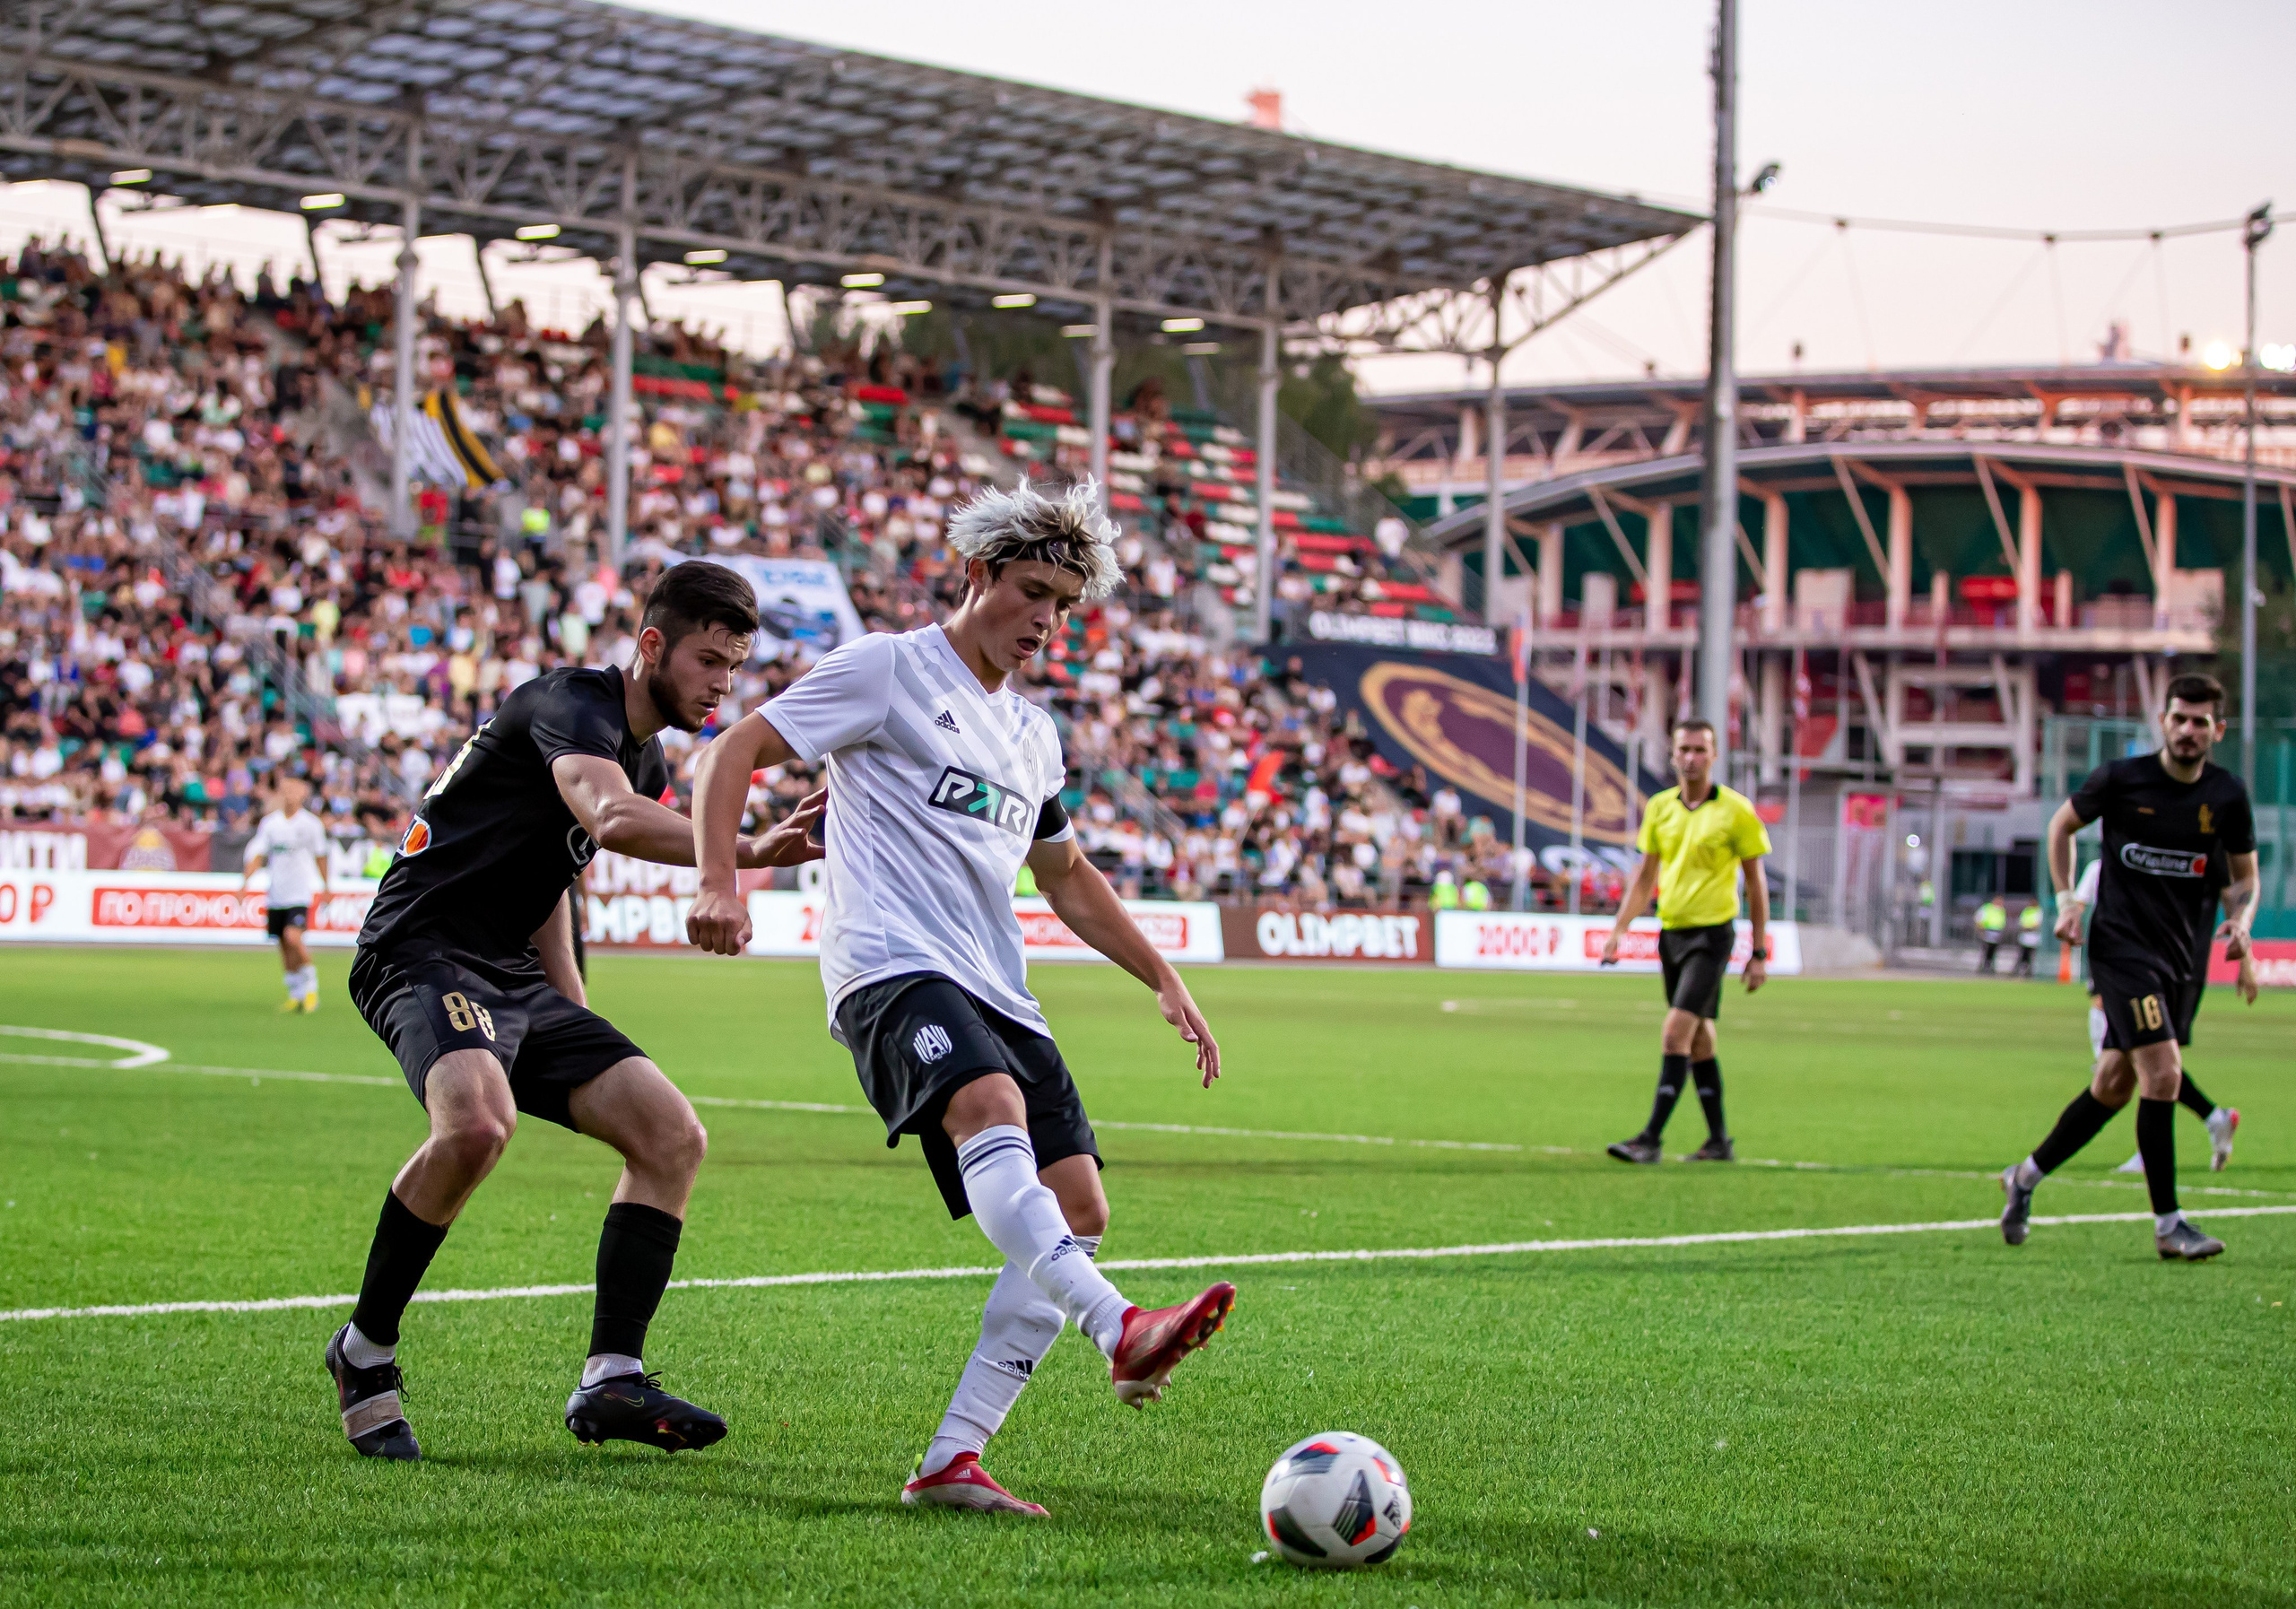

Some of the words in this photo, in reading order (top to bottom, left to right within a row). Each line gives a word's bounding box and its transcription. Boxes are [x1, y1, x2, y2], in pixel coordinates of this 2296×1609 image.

[934, 719, 961, 734] adidas
[935, 771, 1032, 837] PARI
[1257, 911, 1421, 958] OLIMPBET
[441, 991, 496, 1042] 88
[1051, 1242, 1083, 1261] adid
